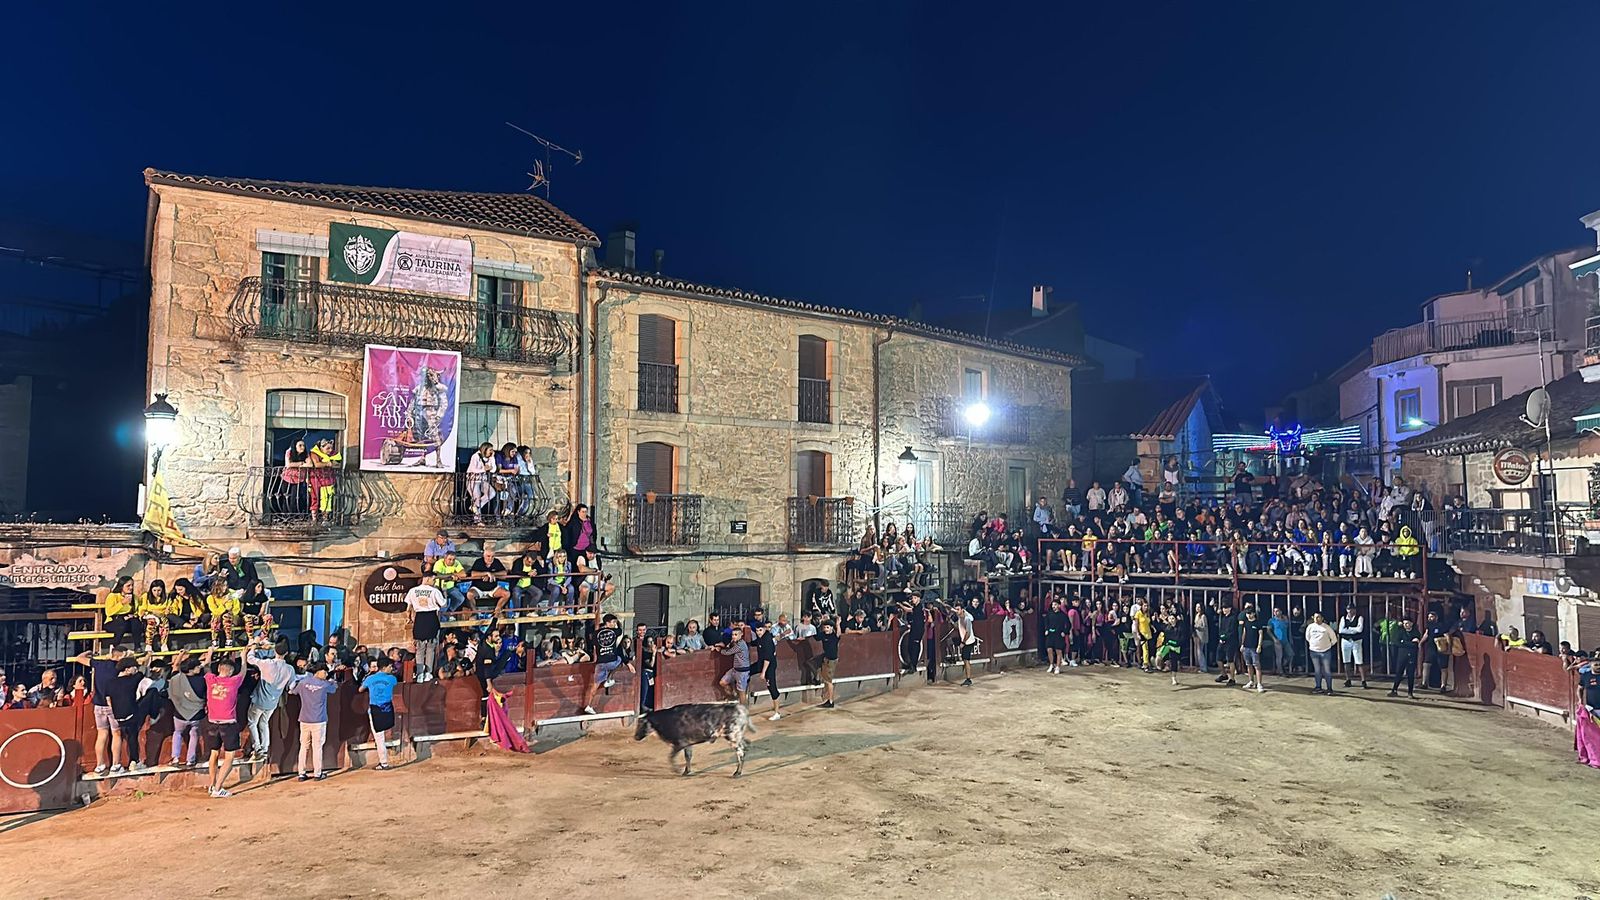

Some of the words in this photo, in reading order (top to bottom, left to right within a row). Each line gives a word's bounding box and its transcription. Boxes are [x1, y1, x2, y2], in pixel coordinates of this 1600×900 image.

[415, 258, 462, 272] TAURINA
[371, 391, 409, 408] SAN
[380, 415, 414, 429] TOLO
[12, 565, 89, 574] ENTRADA
[374, 582, 391, 592] café
[391, 582, 404, 590] bar
[369, 593, 407, 604] CENTRA
